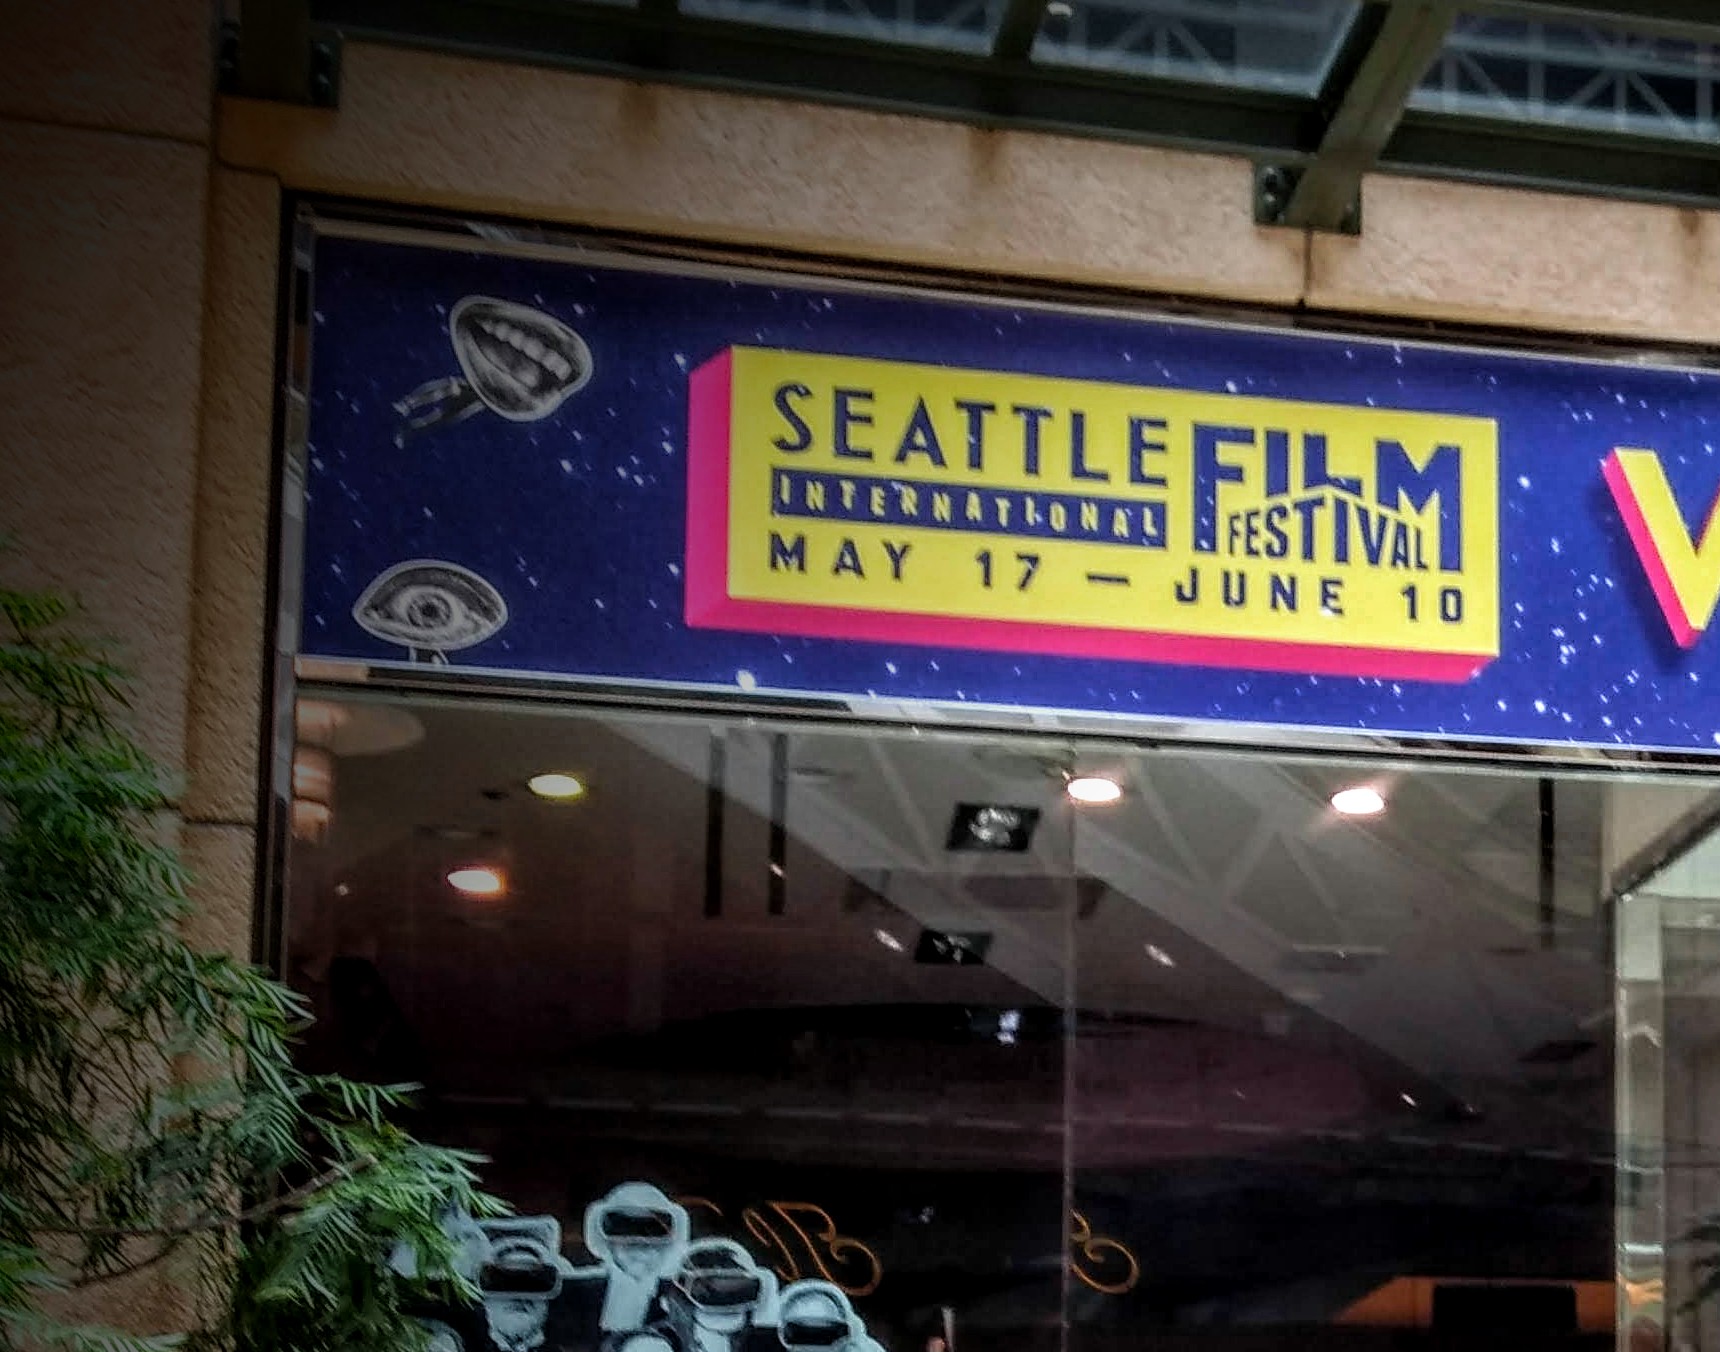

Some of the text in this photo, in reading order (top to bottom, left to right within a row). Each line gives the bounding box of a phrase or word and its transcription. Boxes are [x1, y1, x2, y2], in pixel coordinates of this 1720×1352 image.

[772, 382, 1464, 572] SEATTLE FILM
[778, 473, 1429, 571] INTERNATIONAL FESTIVAL
[768, 532, 914, 582] MAY
[978, 552, 1040, 593] 17
[1176, 566, 1346, 617] JUNE
[1402, 585, 1465, 626] 10
